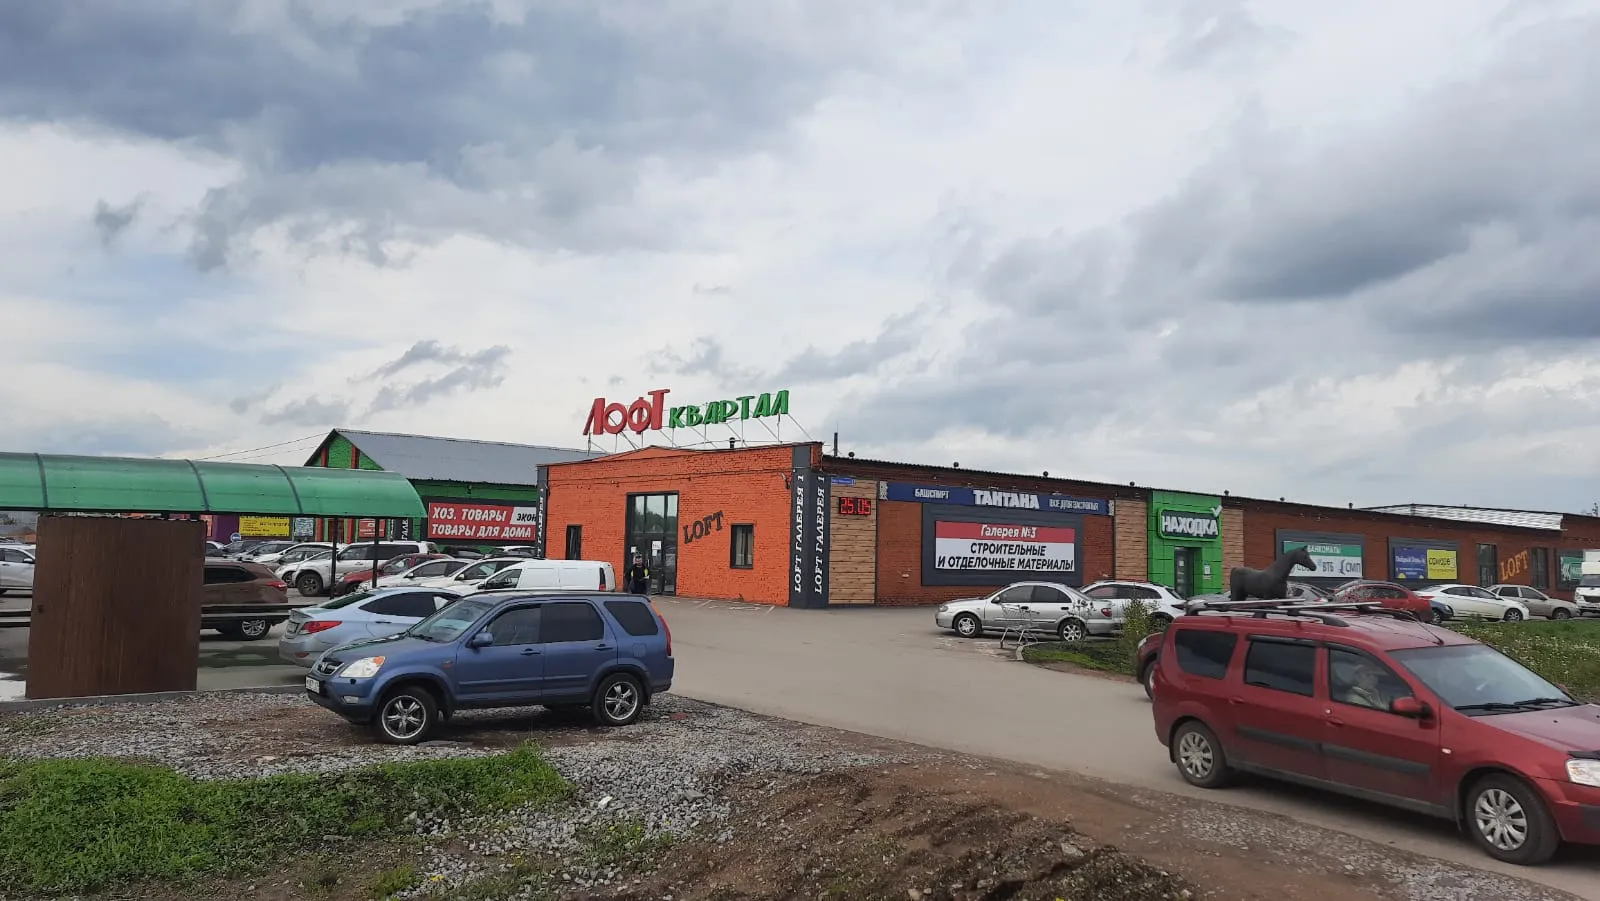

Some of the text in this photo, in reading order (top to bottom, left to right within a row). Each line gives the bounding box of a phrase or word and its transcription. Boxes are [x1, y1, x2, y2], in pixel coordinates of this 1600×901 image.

[583, 389, 789, 435] ЛОФТ КВАРТАЛ
[973, 489, 1040, 509] ТАНТАНА
[432, 506, 507, 522] ХОЗ. ТОВАРЫ
[795, 486, 804, 552] ГАЛЕРЕЯ
[815, 487, 824, 553] ГАЛЕРЕЯ
[432, 523, 531, 538] ТОВАРЫ ДЛЯ ДОМА
[682, 510, 724, 544] LOFT
[981, 524, 1037, 538] Галерея №3
[1161, 515, 1219, 537] НАХОДКА
[970, 542, 1047, 556] СТРОИТЕЛЬНЫЕ
[794, 555, 802, 593] LOFT
[937, 556, 1074, 570] И ОТДЕЛОЧНЫЕ МАТЕРИАЛЫ
[1501, 550, 1528, 580] LOFT
